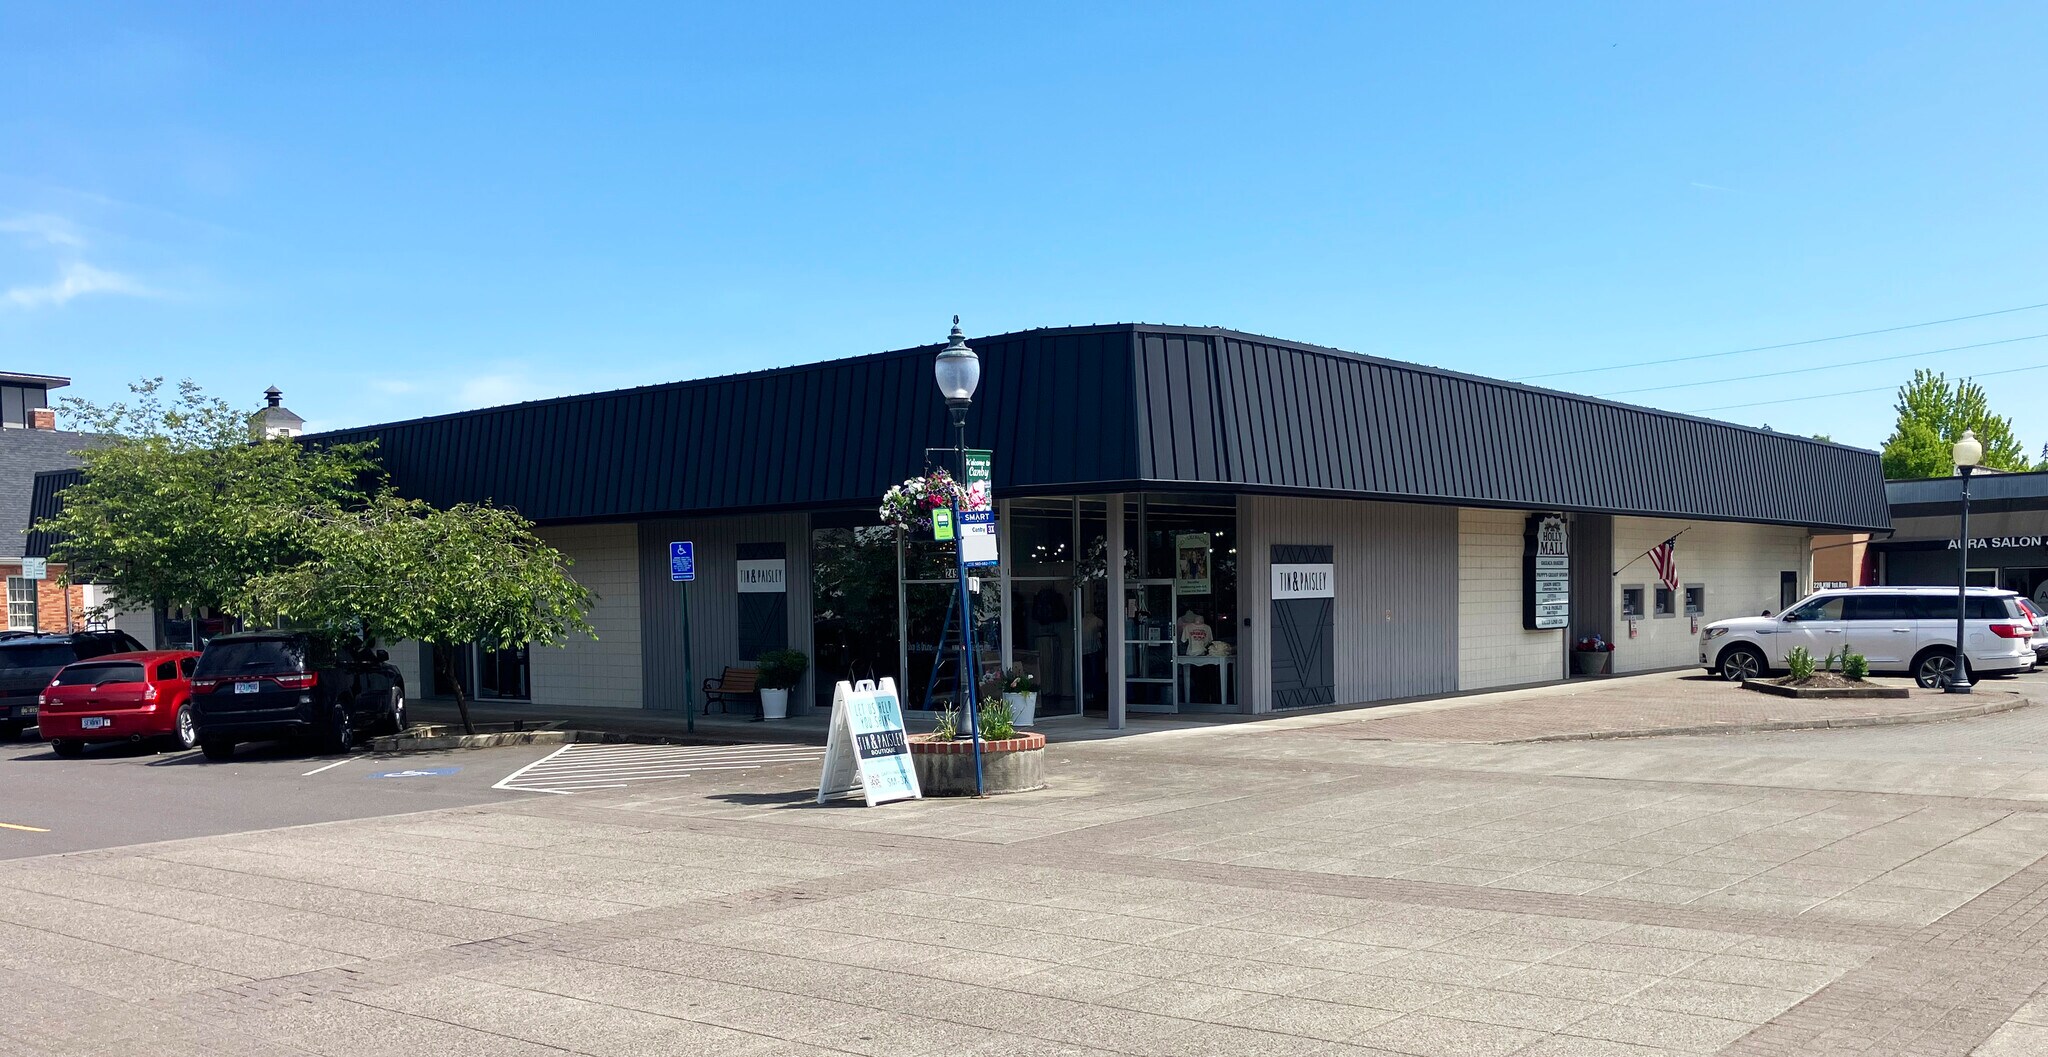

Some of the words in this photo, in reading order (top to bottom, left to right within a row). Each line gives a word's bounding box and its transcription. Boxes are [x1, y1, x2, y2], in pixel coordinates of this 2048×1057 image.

[969, 466, 989, 479] Canby
[965, 513, 989, 521] SMART
[1543, 532, 1562, 541] HOLLY
[1992, 536, 2041, 548] SALON
[1540, 542, 1564, 555] MALL
[855, 703, 864, 716] LET
[868, 702, 876, 715] US
[878, 700, 892, 714] HELP
[860, 716, 872, 728] YOU
[871, 747, 896, 756] BOUTIQUE
